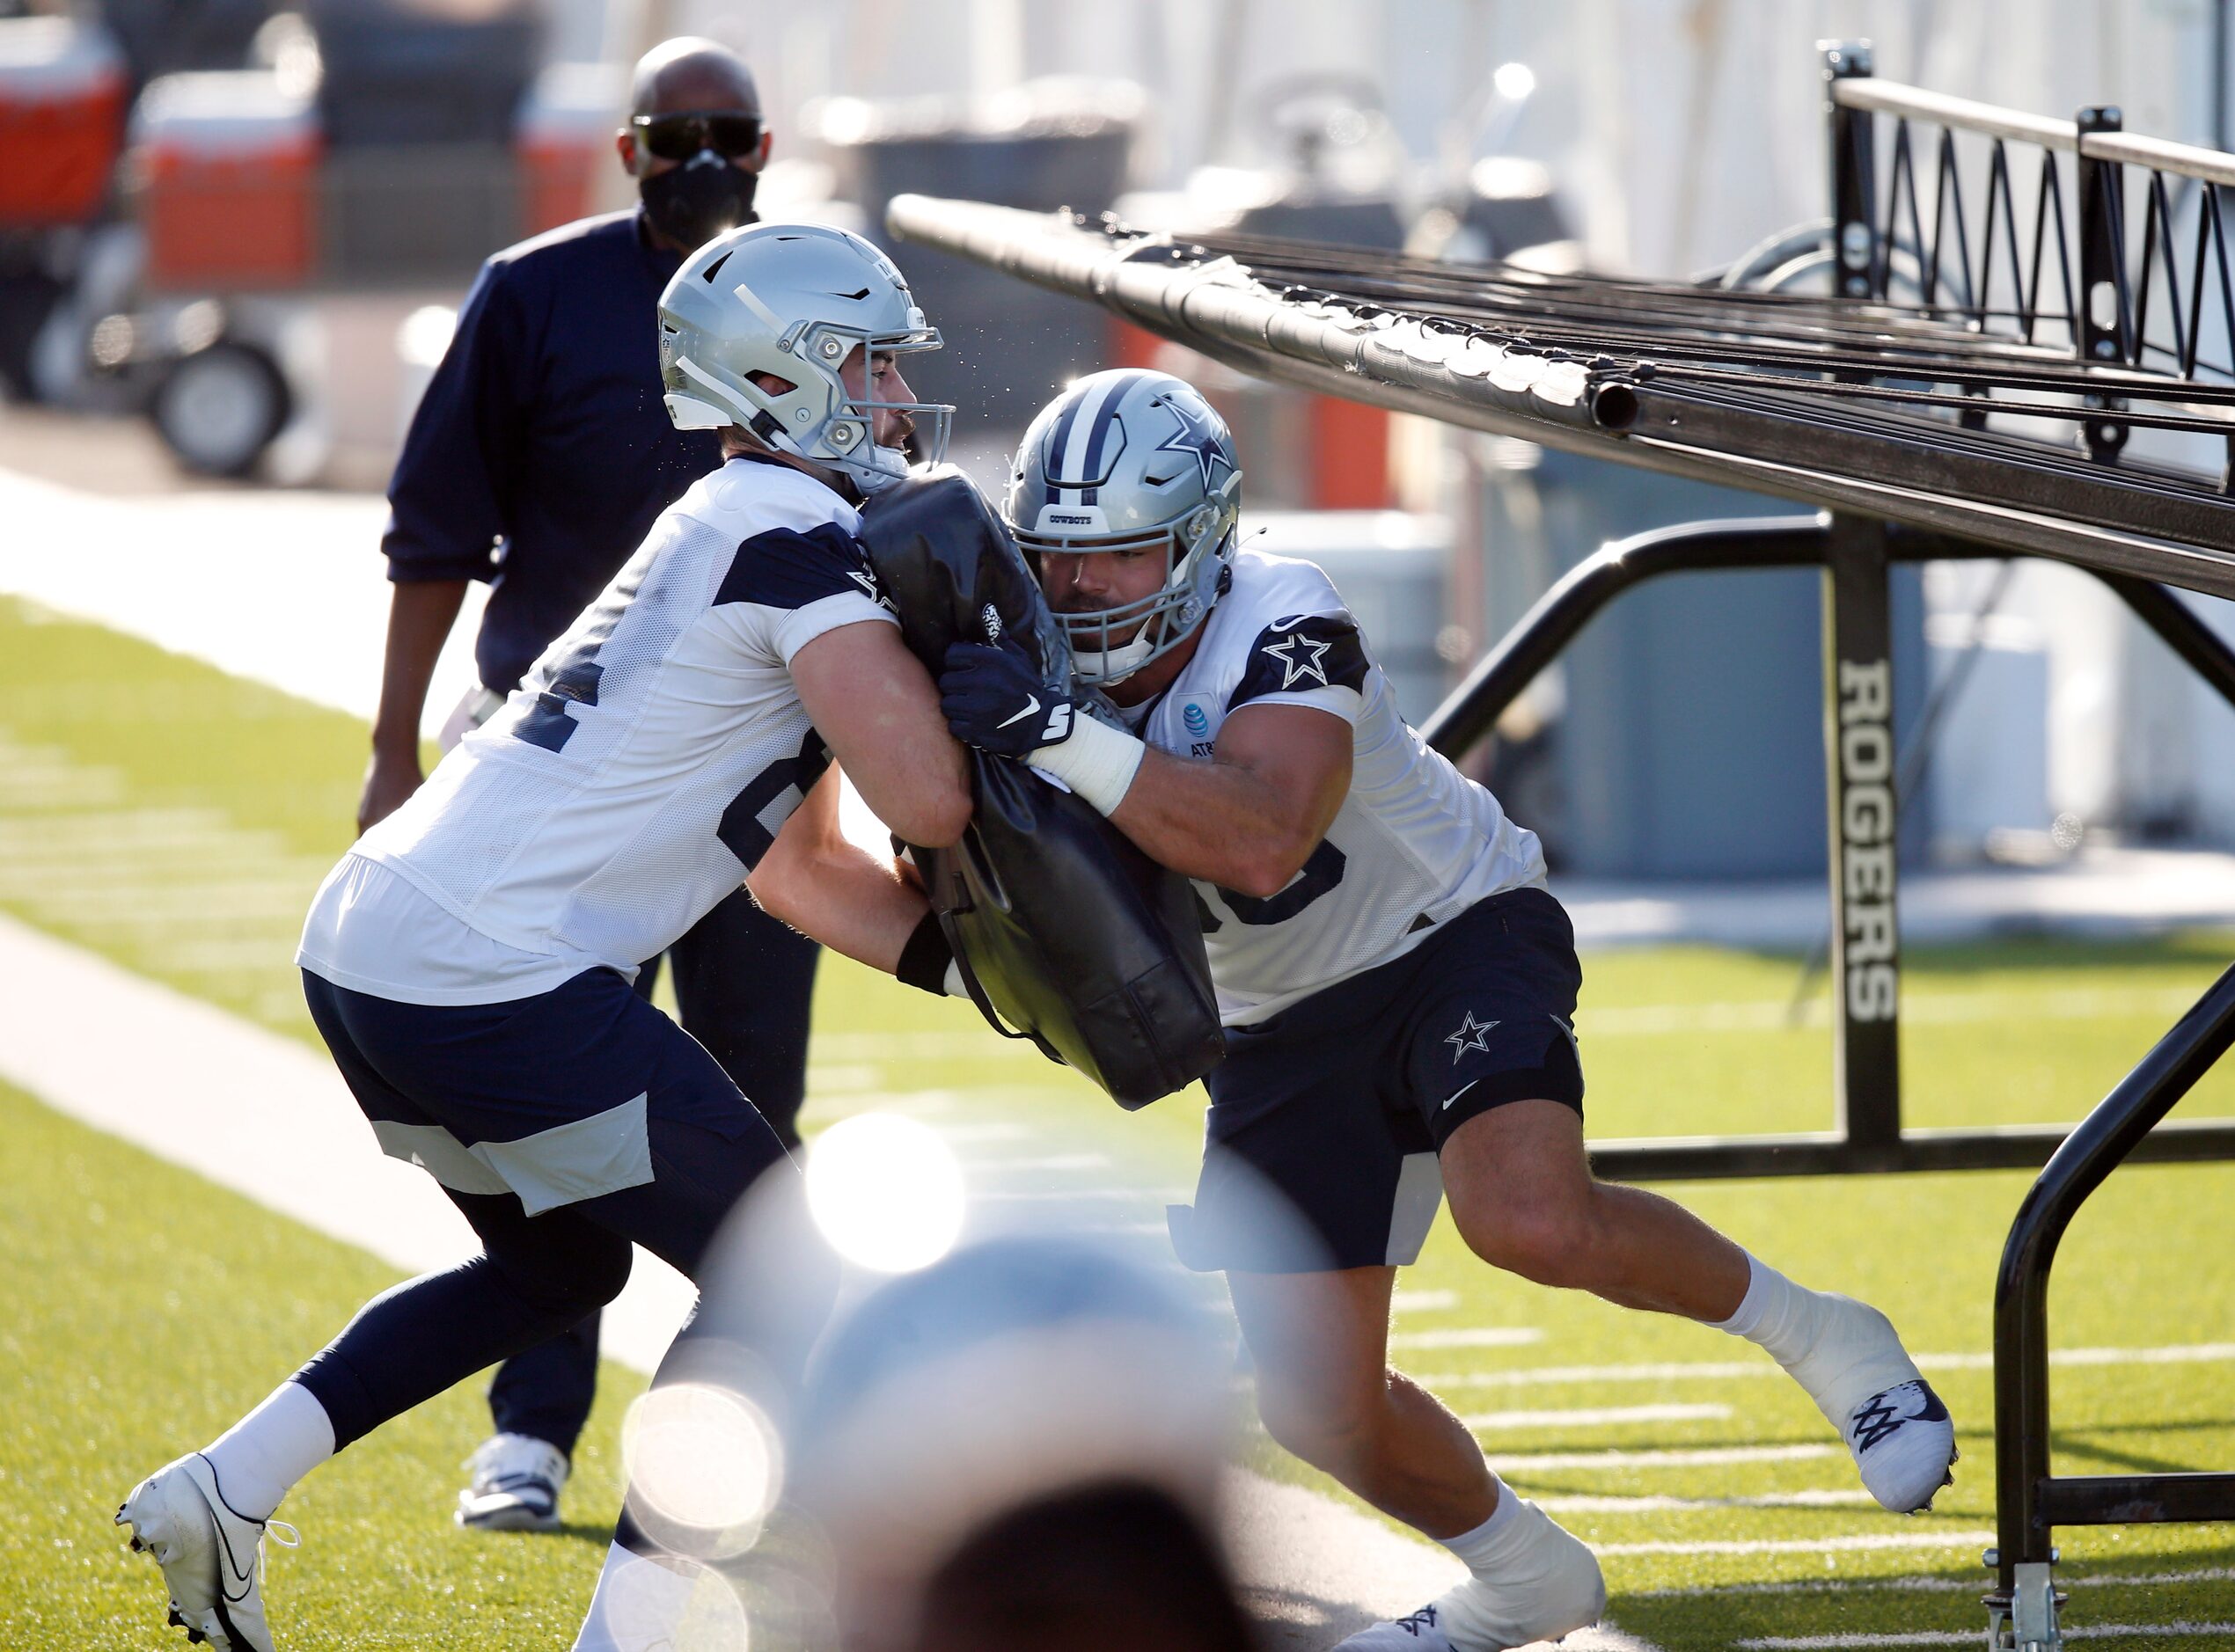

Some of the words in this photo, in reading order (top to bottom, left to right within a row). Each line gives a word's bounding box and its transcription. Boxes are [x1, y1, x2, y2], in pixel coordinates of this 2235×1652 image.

[1050, 515, 1092, 524] COWBOYS
[1191, 741, 1214, 757] AT&
[1840, 660, 1898, 1021] ROGERS
